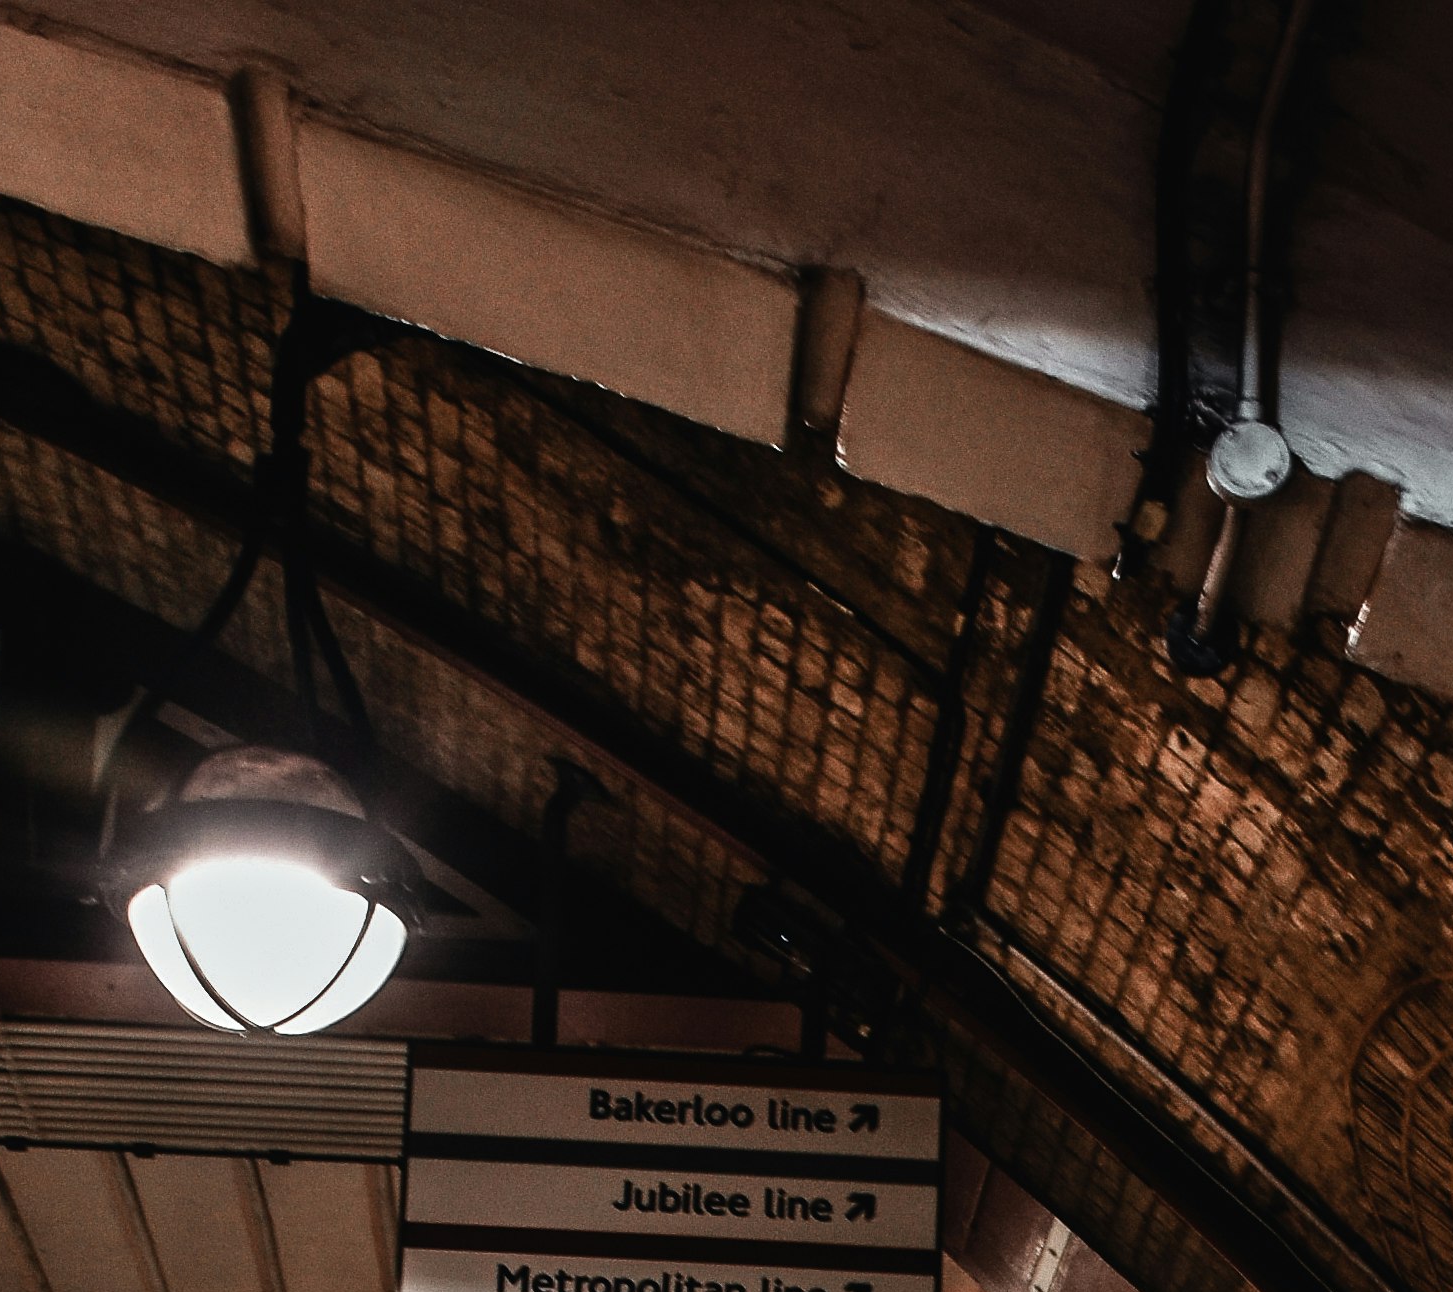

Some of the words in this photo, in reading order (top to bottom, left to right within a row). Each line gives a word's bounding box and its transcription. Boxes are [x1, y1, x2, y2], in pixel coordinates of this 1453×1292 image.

[590, 1088, 754, 1128] Bakerloo
[768, 1097, 836, 1132] line
[612, 1180, 751, 1216] Jubilee
[764, 1188, 833, 1222] line
